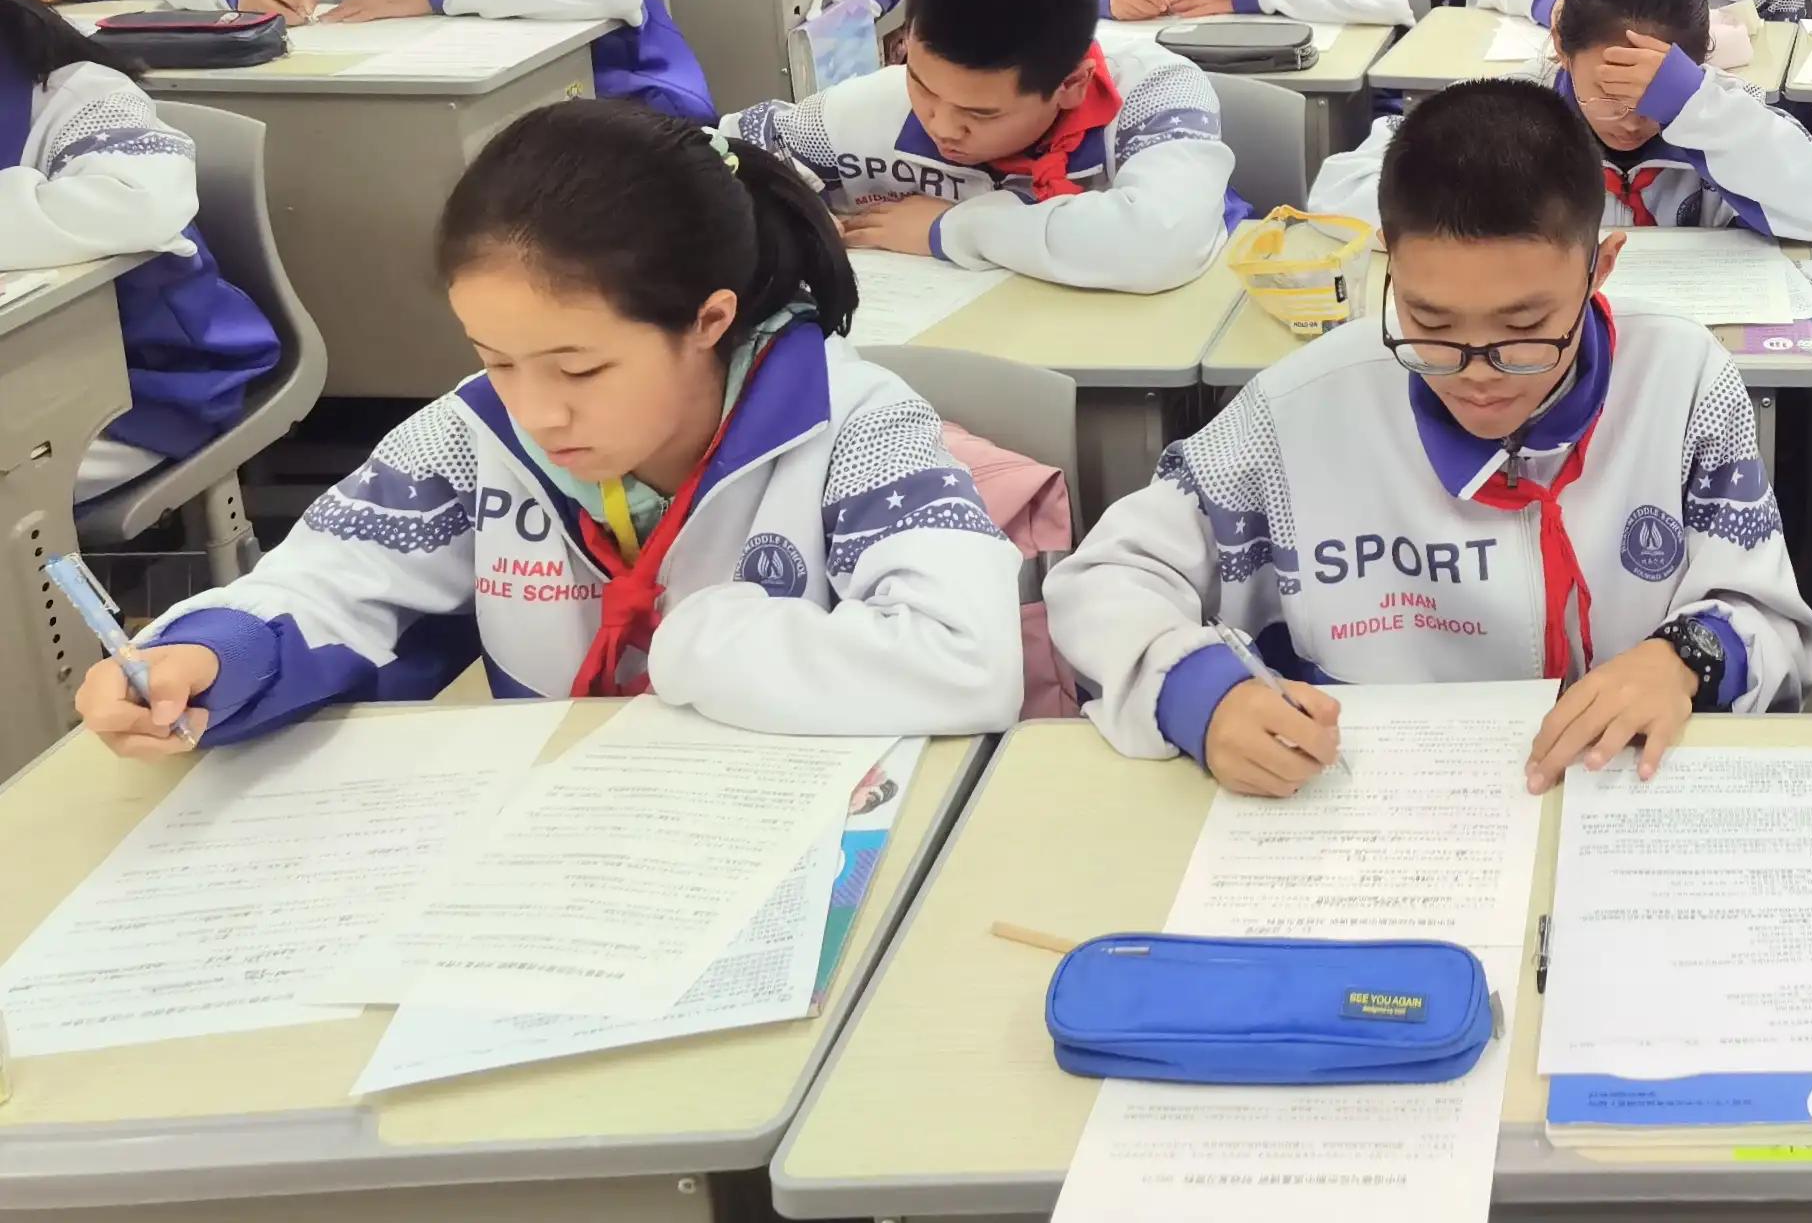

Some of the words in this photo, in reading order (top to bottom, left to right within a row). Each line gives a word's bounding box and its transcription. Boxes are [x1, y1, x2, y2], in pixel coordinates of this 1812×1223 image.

[836, 152, 966, 201] SPORT
[1314, 533, 1498, 584] SPORT
[524, 583, 602, 602] SCHOOL
[1330, 613, 1405, 641] MIDDLE
[1413, 613, 1488, 636] SCHOOL
[1349, 992, 1369, 1004] SEE
[1371, 993, 1392, 1006] YOU
[1392, 995, 1422, 1008] AGAIN
